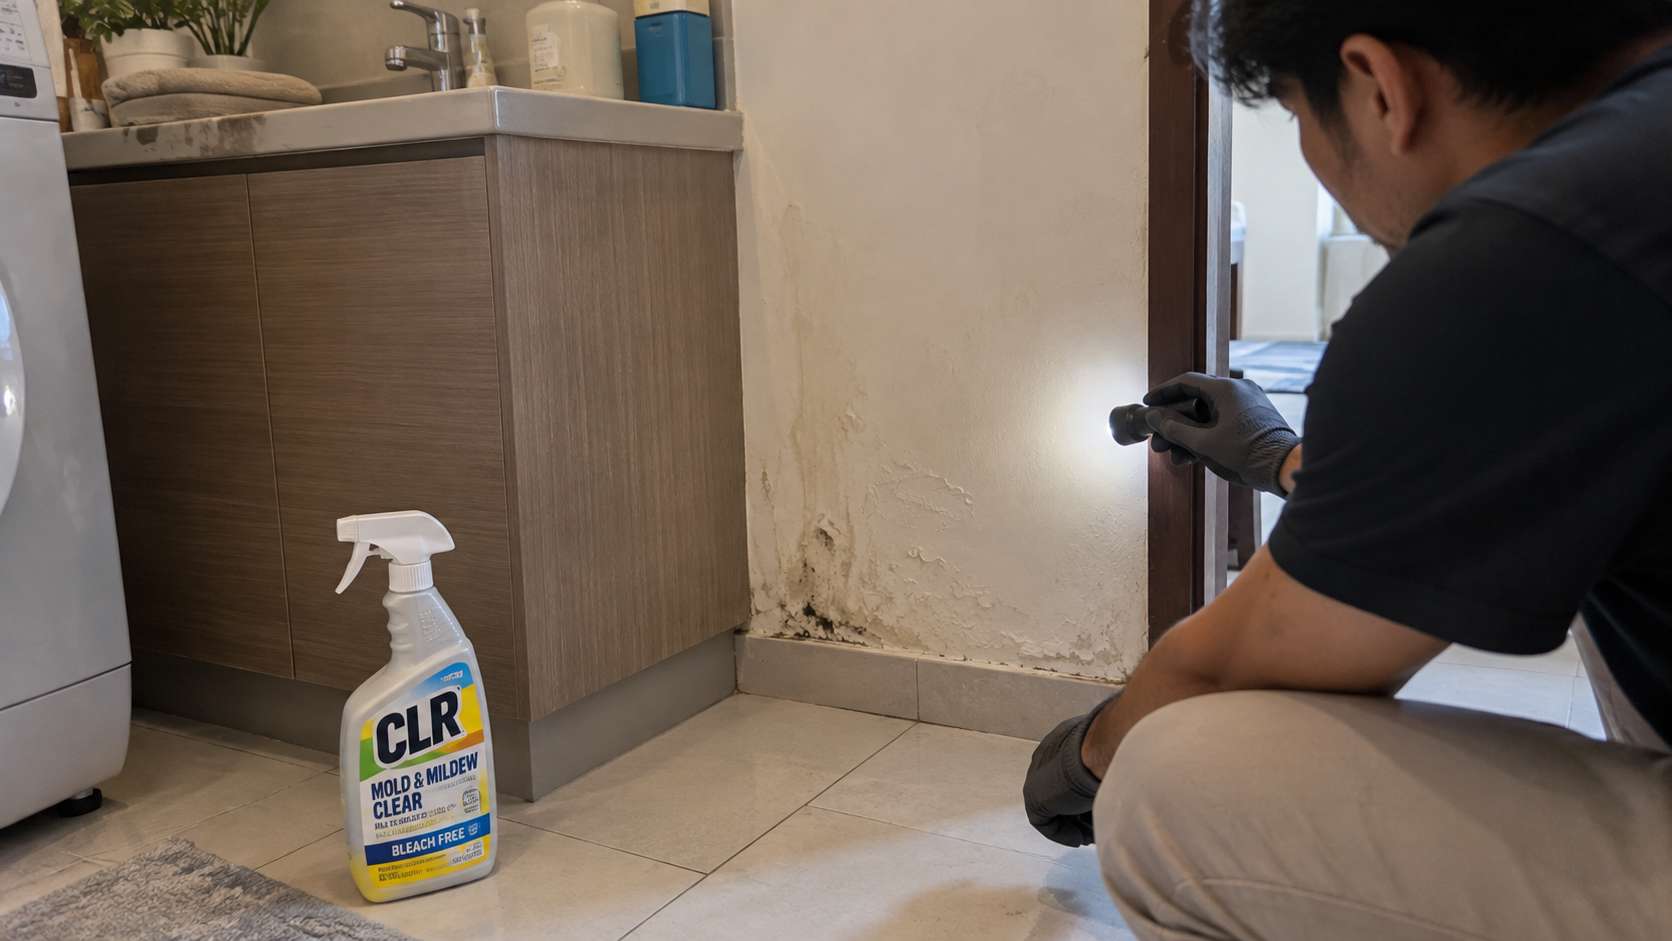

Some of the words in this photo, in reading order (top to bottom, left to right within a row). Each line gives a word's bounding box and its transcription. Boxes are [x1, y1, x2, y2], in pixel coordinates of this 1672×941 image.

[376, 690, 461, 764] CLR
[371, 775, 411, 800] MOLD
[414, 772, 424, 788] &
[426, 752, 478, 786] MILDEW
[373, 791, 422, 819] CLEAR
[392, 838, 435, 857] BLEACH
[438, 827, 465, 846] FREE
